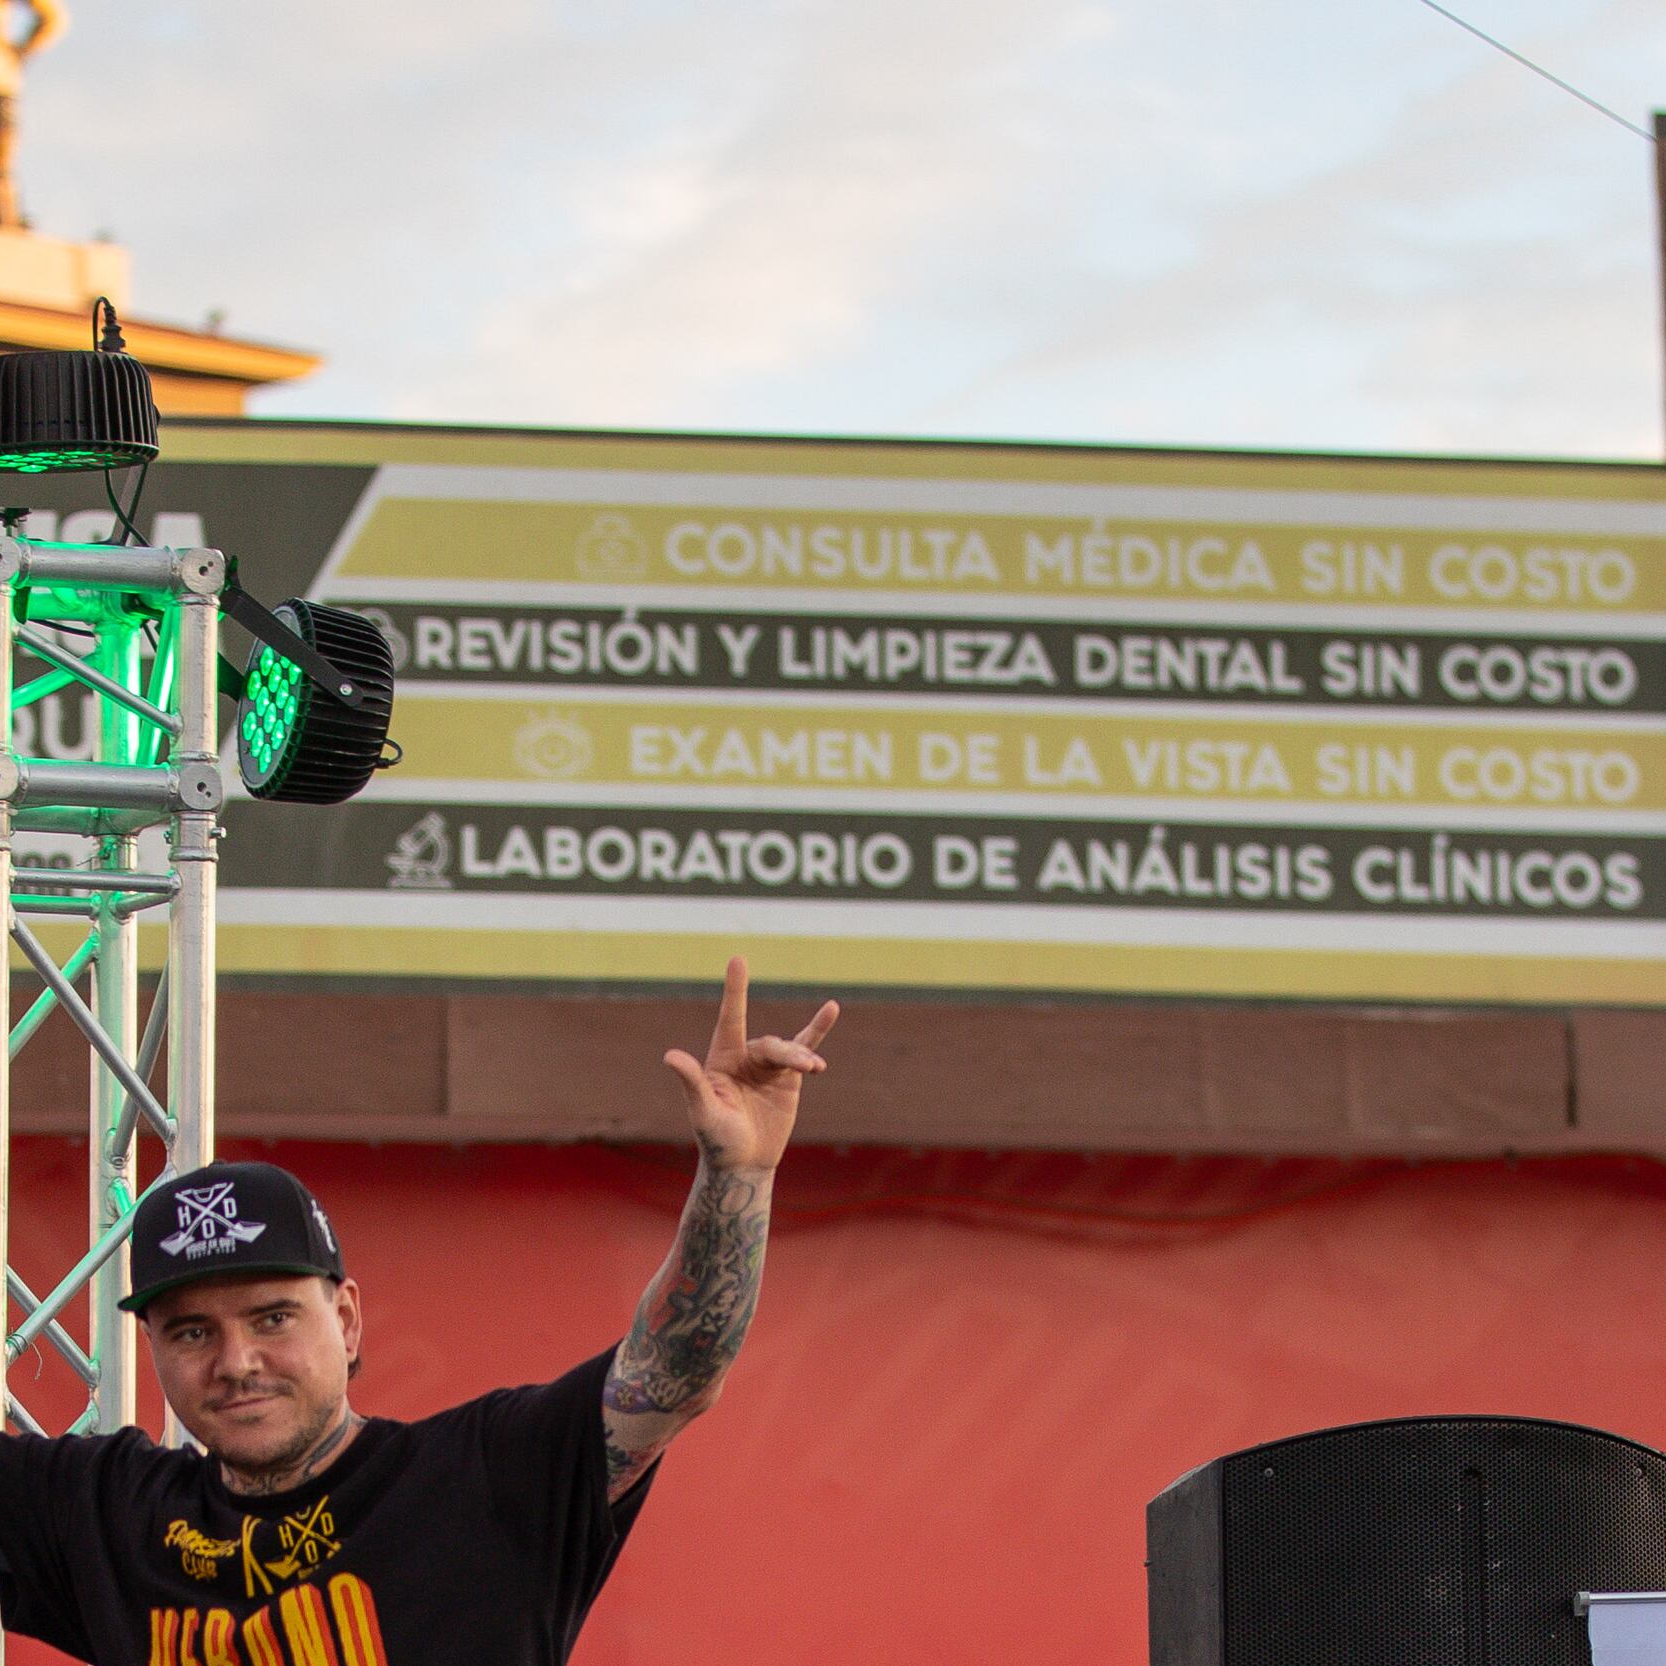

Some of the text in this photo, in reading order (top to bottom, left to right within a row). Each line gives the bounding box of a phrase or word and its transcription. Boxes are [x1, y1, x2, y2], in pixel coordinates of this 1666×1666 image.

[664, 516, 1636, 601] CONSULTA MÉDICA SIN COSTO
[415, 605, 1638, 702] REVISIÓN Y LIMPIEZA DENTAL SIN COSTO
[631, 724, 1639, 802] EXAMEN DE LA VISTA SIN COSTO
[461, 824, 1643, 908] LABORATORIO DE ANÁLISIS CLÍNICOS
